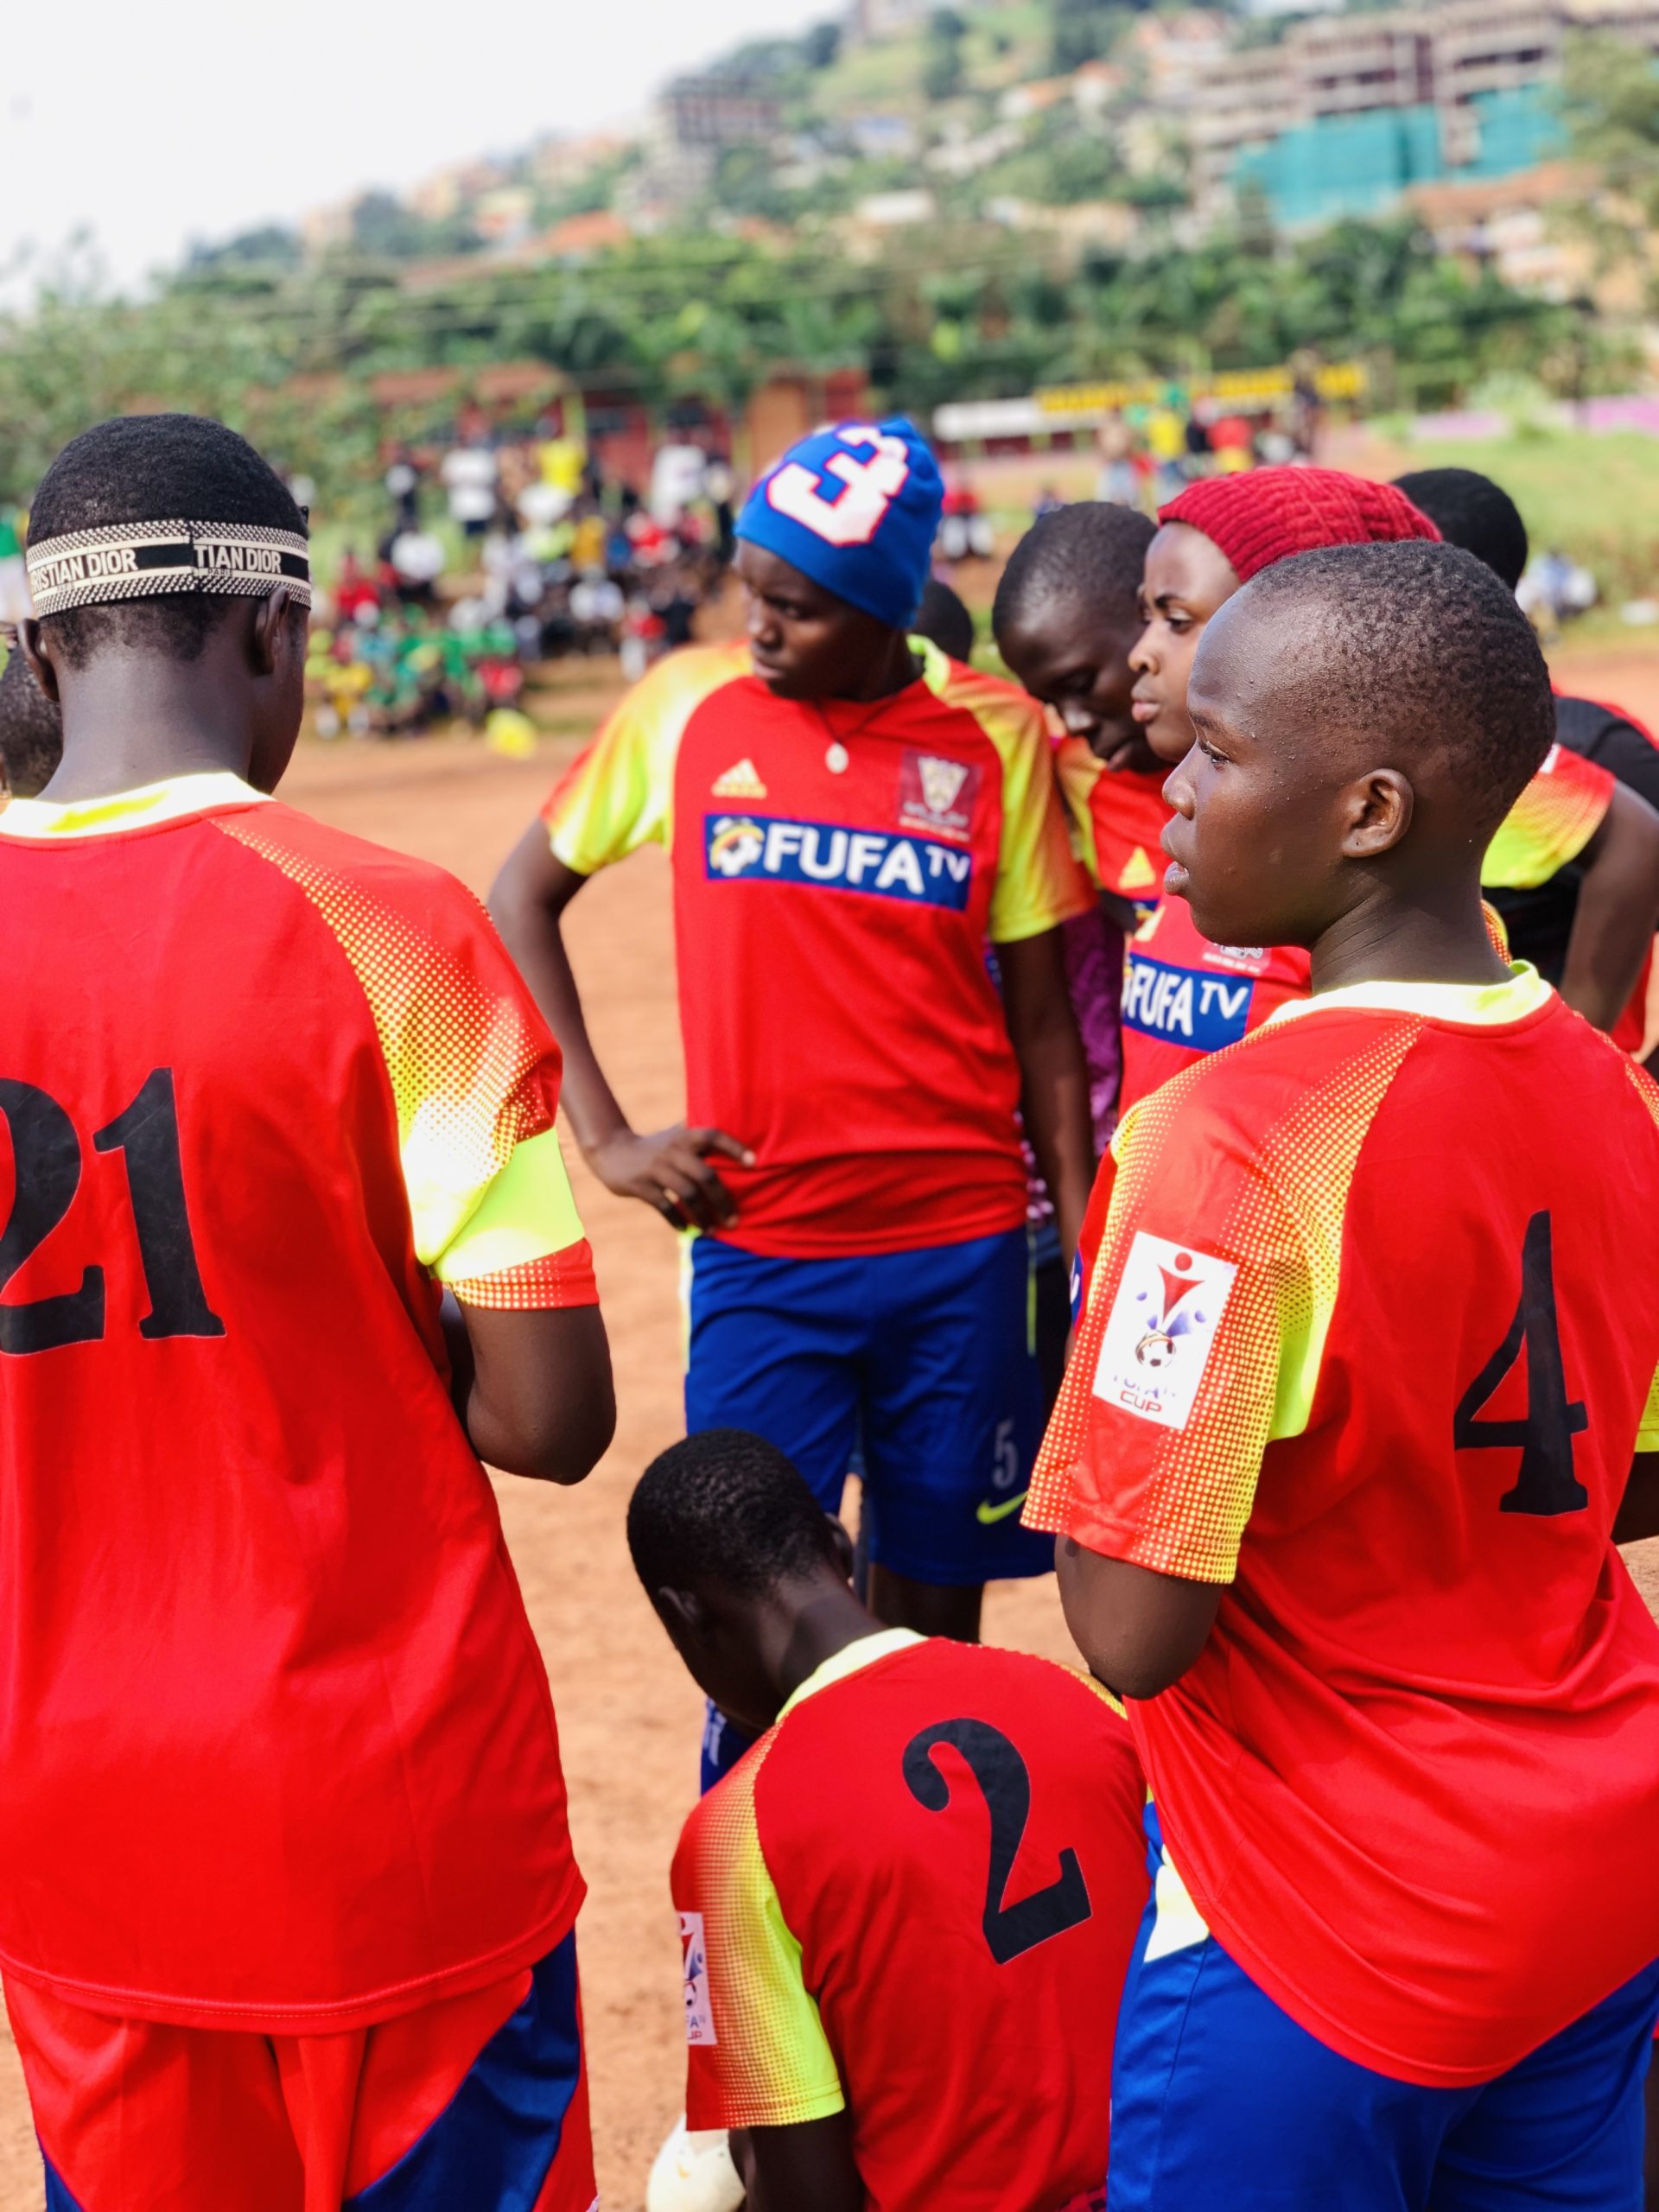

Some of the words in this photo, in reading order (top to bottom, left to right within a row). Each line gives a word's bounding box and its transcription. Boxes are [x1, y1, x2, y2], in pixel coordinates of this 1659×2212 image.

[766, 426, 910, 547] 3
[87, 548, 138, 577] DIOR
[246, 548, 282, 575] DIOR
[763, 823, 925, 895] FUFA
[925, 845, 970, 882] TV
[1127, 963, 1193, 1037] FUFA
[1199, 980, 1249, 1020] TV
[0, 1066, 227, 1357] 21
[1453, 1209, 1589, 1516] 4
[1119, 1389, 1162, 1412] CUP
[992, 1418, 1019, 1490] 5
[901, 1718, 1092, 1965] 2
